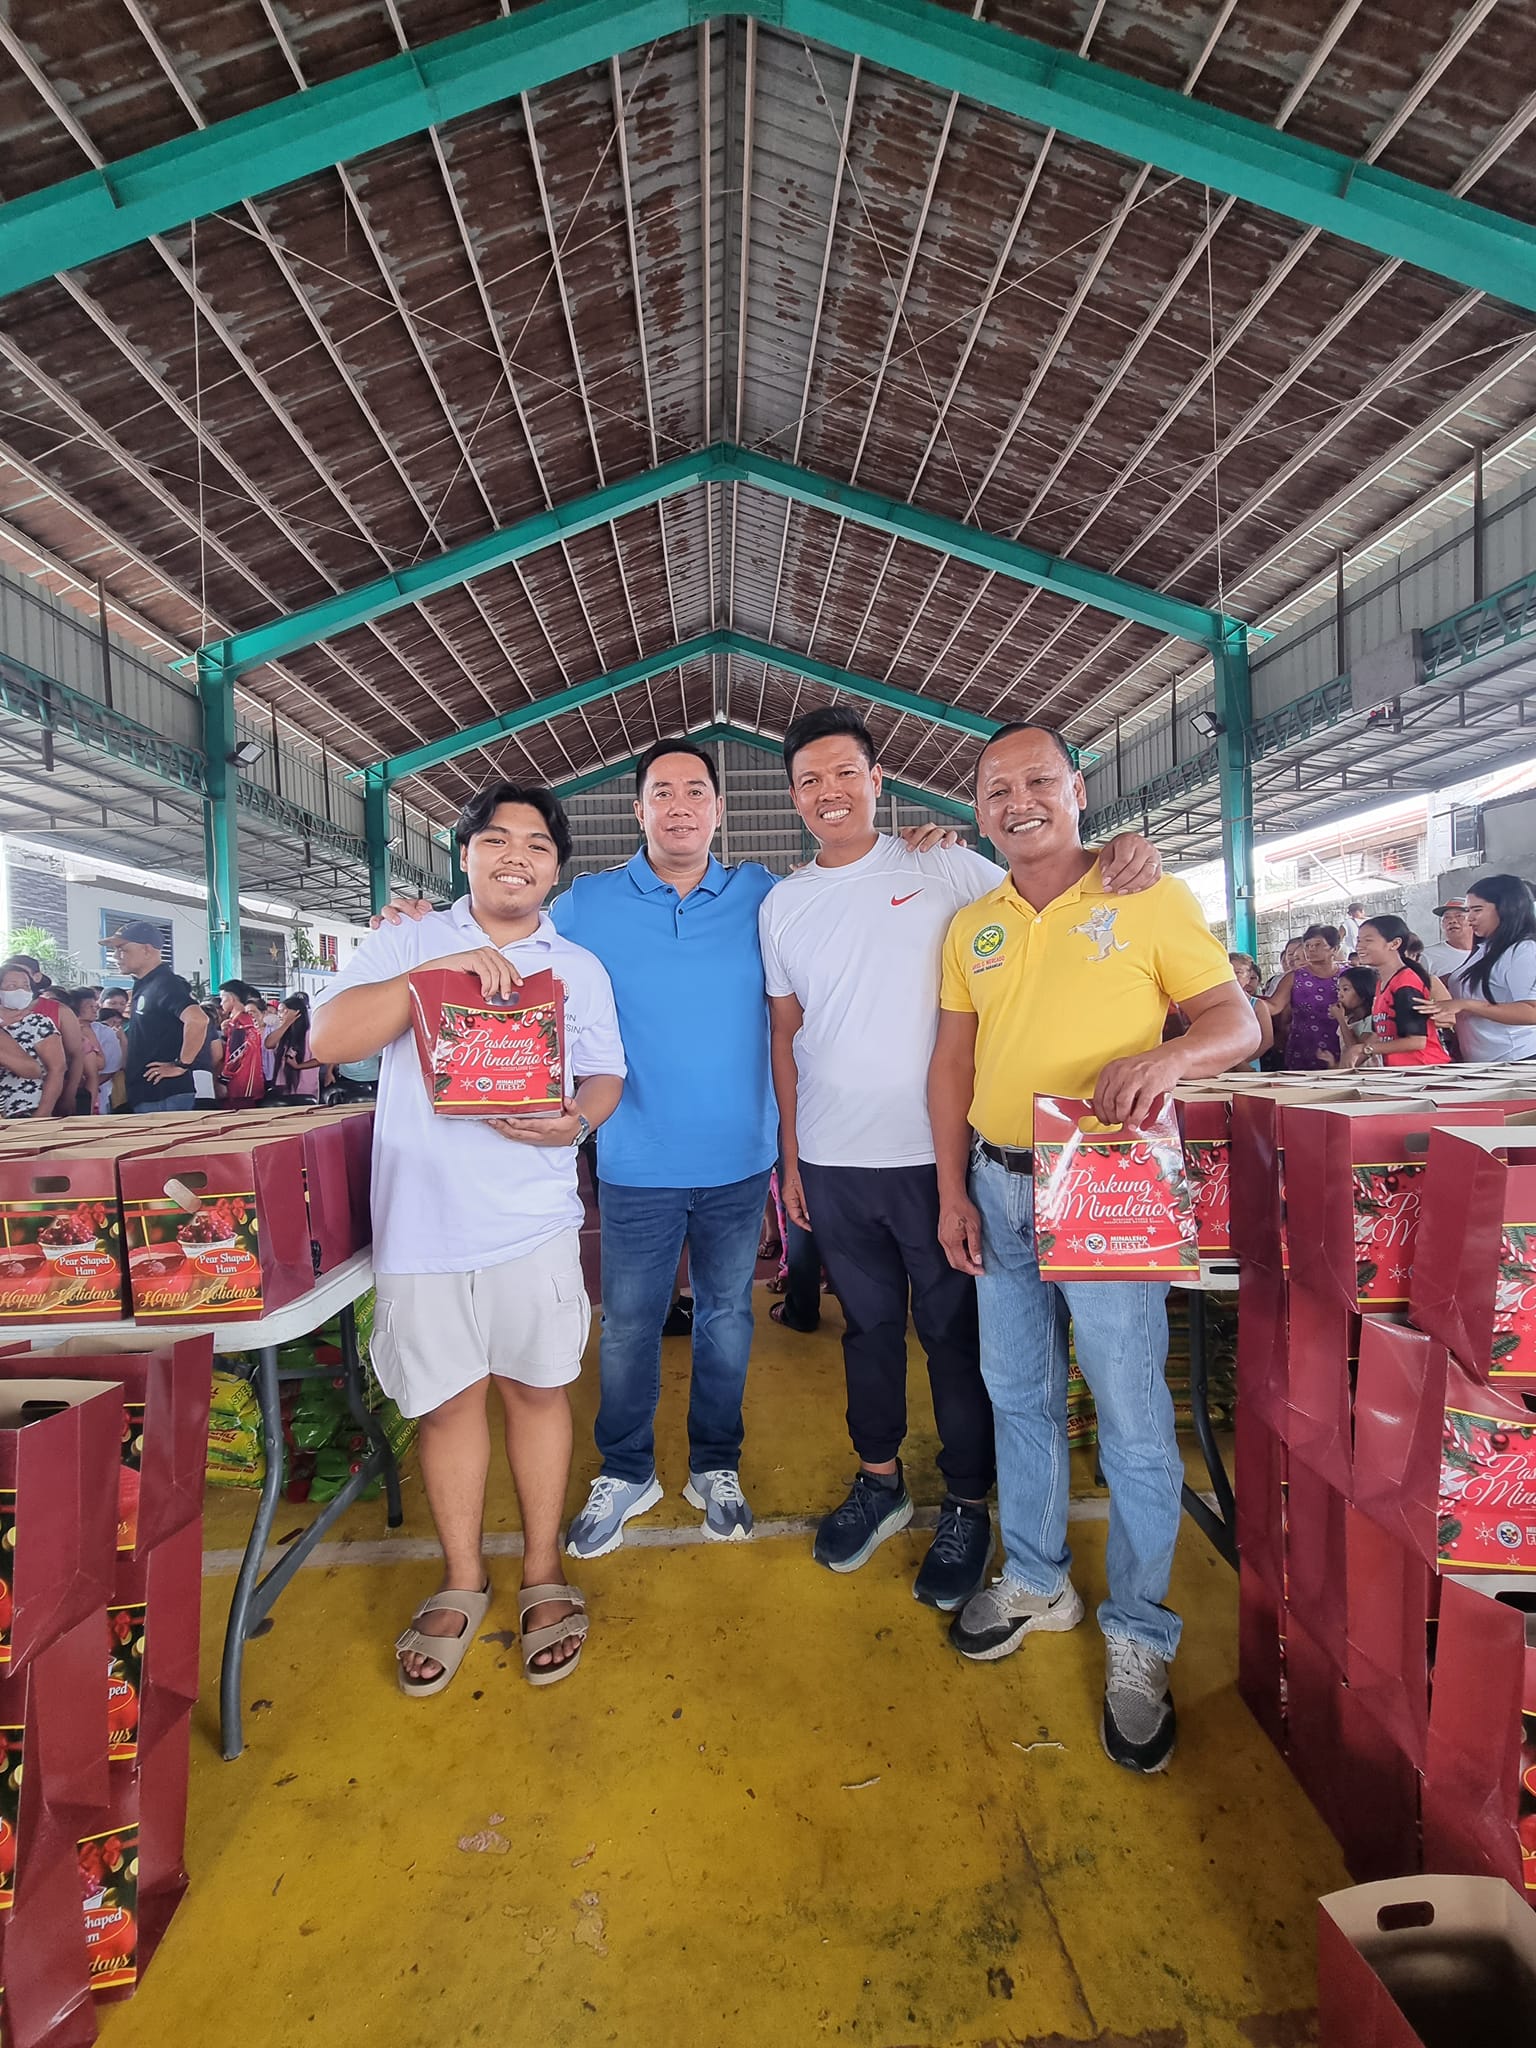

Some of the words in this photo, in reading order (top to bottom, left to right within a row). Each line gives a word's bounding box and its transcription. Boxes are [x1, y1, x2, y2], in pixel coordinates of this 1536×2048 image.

[463, 1029, 535, 1055] Paskung
[1063, 1169, 1154, 1202] Paskung
[1111, 1242, 1140, 1250] FIRST
[60, 1257, 78, 1266] Pear
[80, 1254, 110, 1267] Shaped
[200, 1254, 218, 1264] Pear
[220, 1251, 251, 1265] Shaped
[75, 1267, 97, 1276] Ham
[216, 1264, 237, 1274] Ham
[0, 1289, 46, 1308] Happy
[51, 1286, 117, 1305] Holidays
[138, 1287, 189, 1308] Happy
[193, 1283, 258, 1304] Holidays
[108, 1681, 128, 1700] ped
[84, 1906, 122, 1929] haped
